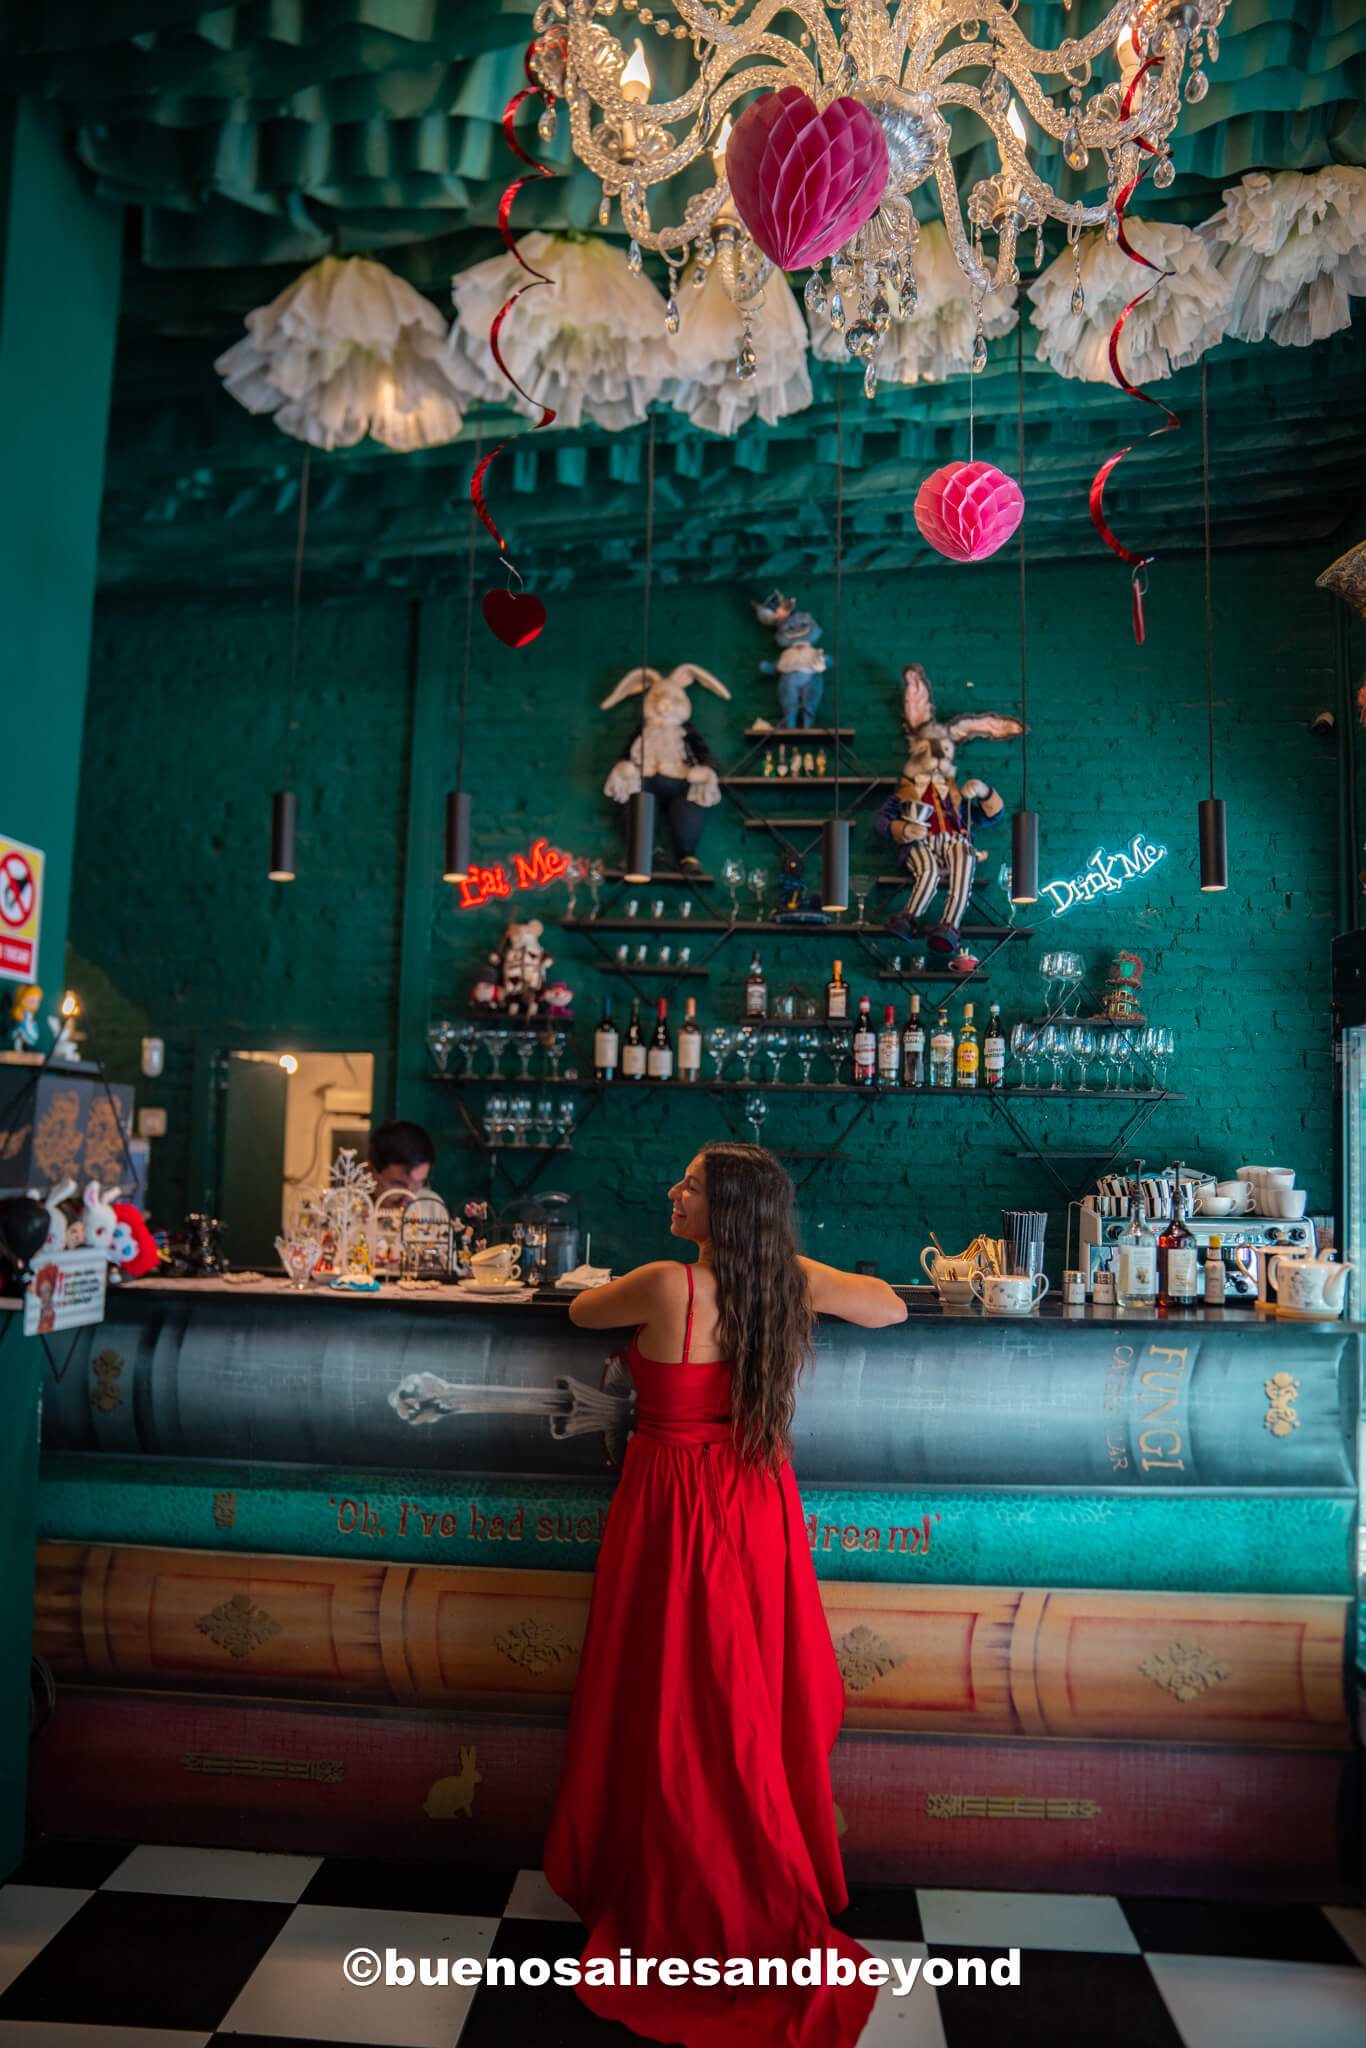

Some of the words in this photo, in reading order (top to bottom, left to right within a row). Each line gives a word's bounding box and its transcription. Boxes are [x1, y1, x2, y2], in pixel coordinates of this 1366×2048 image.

[459, 865, 511, 908] Eat
[514, 839, 570, 889] Me
[1138, 1344, 1188, 1472] FUNGI
[398, 1503, 457, 1538] I've
[468, 1505, 526, 1541] had
